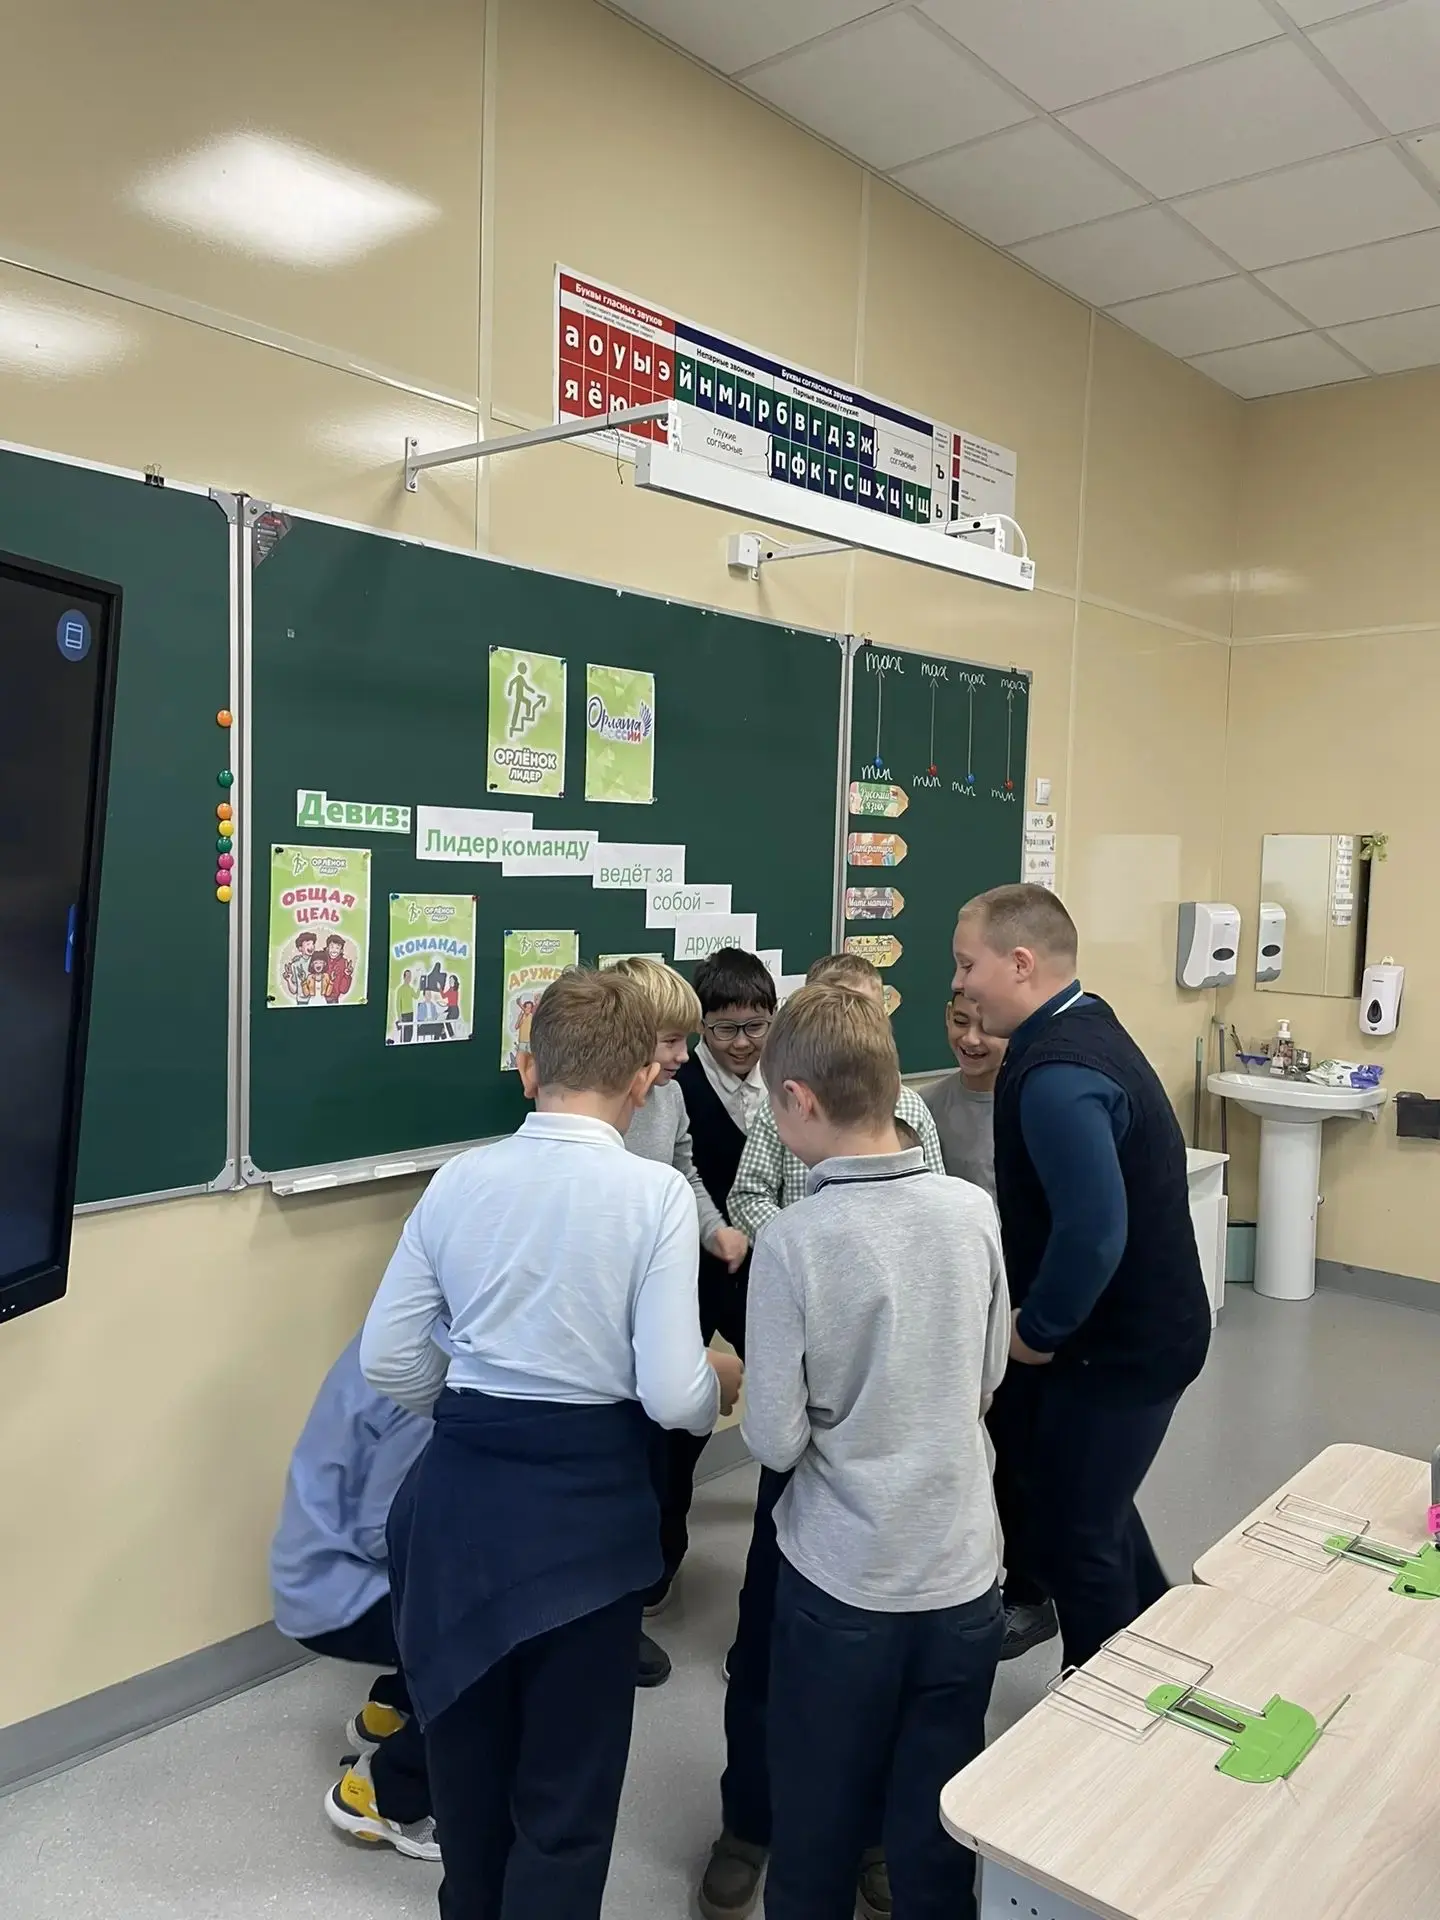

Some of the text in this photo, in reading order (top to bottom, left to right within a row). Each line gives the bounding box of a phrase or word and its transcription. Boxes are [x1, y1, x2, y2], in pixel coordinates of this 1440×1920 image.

[575, 282, 602, 302] Буквы
[603, 295, 636, 316] гласных
[636, 310, 663, 326] звуков
[566, 326, 670, 380] а о у ы э
[696, 348, 755, 378] Непарные звонкие
[565, 380, 578, 400] я
[588, 380, 602, 409] ё
[782, 369, 853, 403] Буквы согласных звуков
[680, 362, 872, 455] й н м л р б в г д з ж
[792, 386, 859, 417] Парные звонкие/глухие
[712, 426, 736, 442] глухие
[706, 436, 743, 456] согласные
[892, 446, 914, 461] звонкие
[890, 456, 917, 472] согласные
[776, 451, 929, 518] п ф к т с ш х ц ч щ
[865, 652, 904, 674] max
[921, 661, 949, 681] max
[960, 671, 986, 686] max
[1000, 678, 1026, 693] max
[588, 696, 641, 732] Орлята
[494, 748, 557, 769] ОРЛЁНОК
[509, 768, 542, 782] ЛИДЕР
[862, 765, 893, 780] min
[913, 774, 941, 788] min
[952, 783, 976, 797] min
[991, 788, 1016, 802] min
[299, 792, 409, 828] Девиз:
[425, 829, 498, 858] Лидер
[502, 839, 590, 861] команду
[312, 857, 346, 868] ОРЛЁНОК
[600, 864, 672, 886] ведёт за
[282, 887, 355, 909] ОБЩАЯ
[652, 893, 701, 911] собой
[296, 907, 340, 925] ЦЕЛЬ
[424, 906, 455, 915] ОРЛЁНОК
[394, 939, 468, 958] КОМАНДА
[685, 934, 741, 955] дружен
[509, 967, 562, 990] ДРУЖБ
